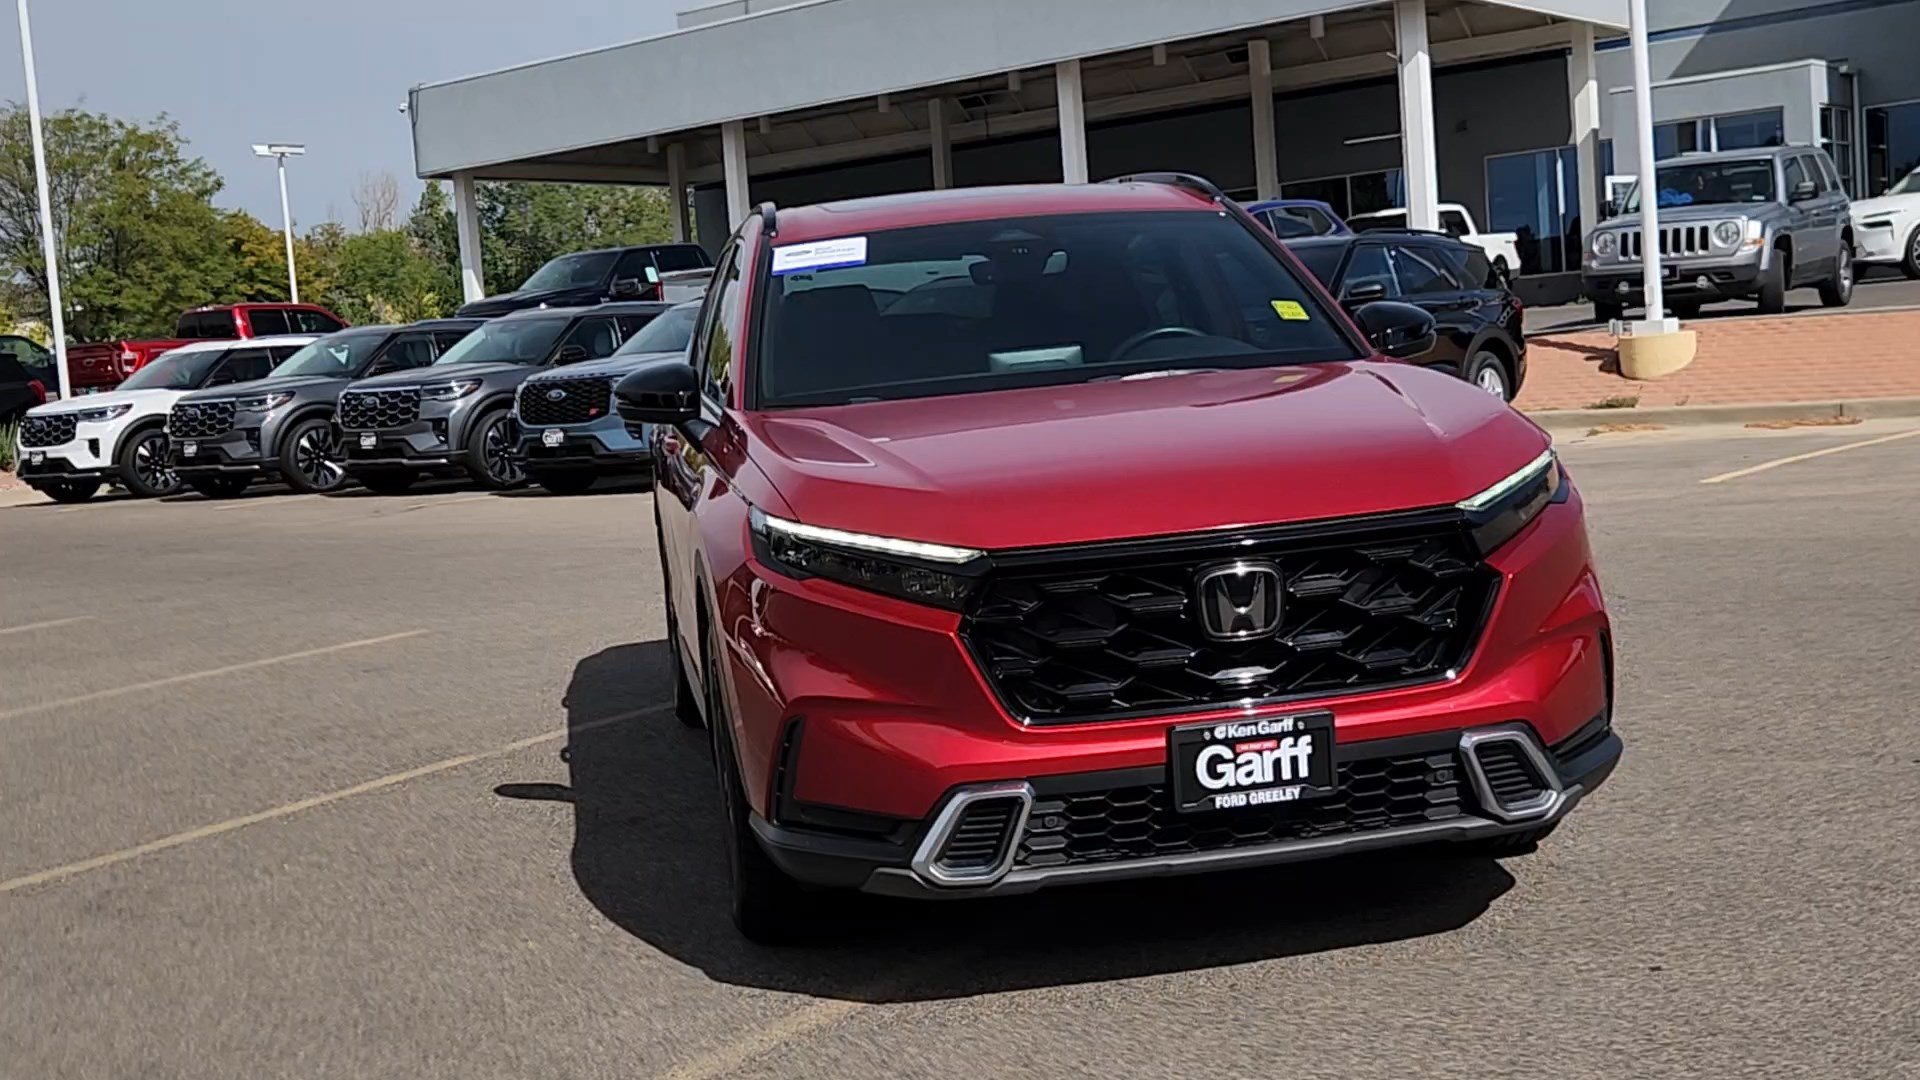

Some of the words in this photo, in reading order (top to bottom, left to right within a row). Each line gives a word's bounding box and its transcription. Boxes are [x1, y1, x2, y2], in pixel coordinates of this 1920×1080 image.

[1227, 723, 1257, 738] Ken
[1257, 717, 1294, 735] Garff
[1195, 735, 1313, 789] Garff
[1215, 794, 1248, 809] FORD
[1249, 787, 1300, 805] GREELEY
